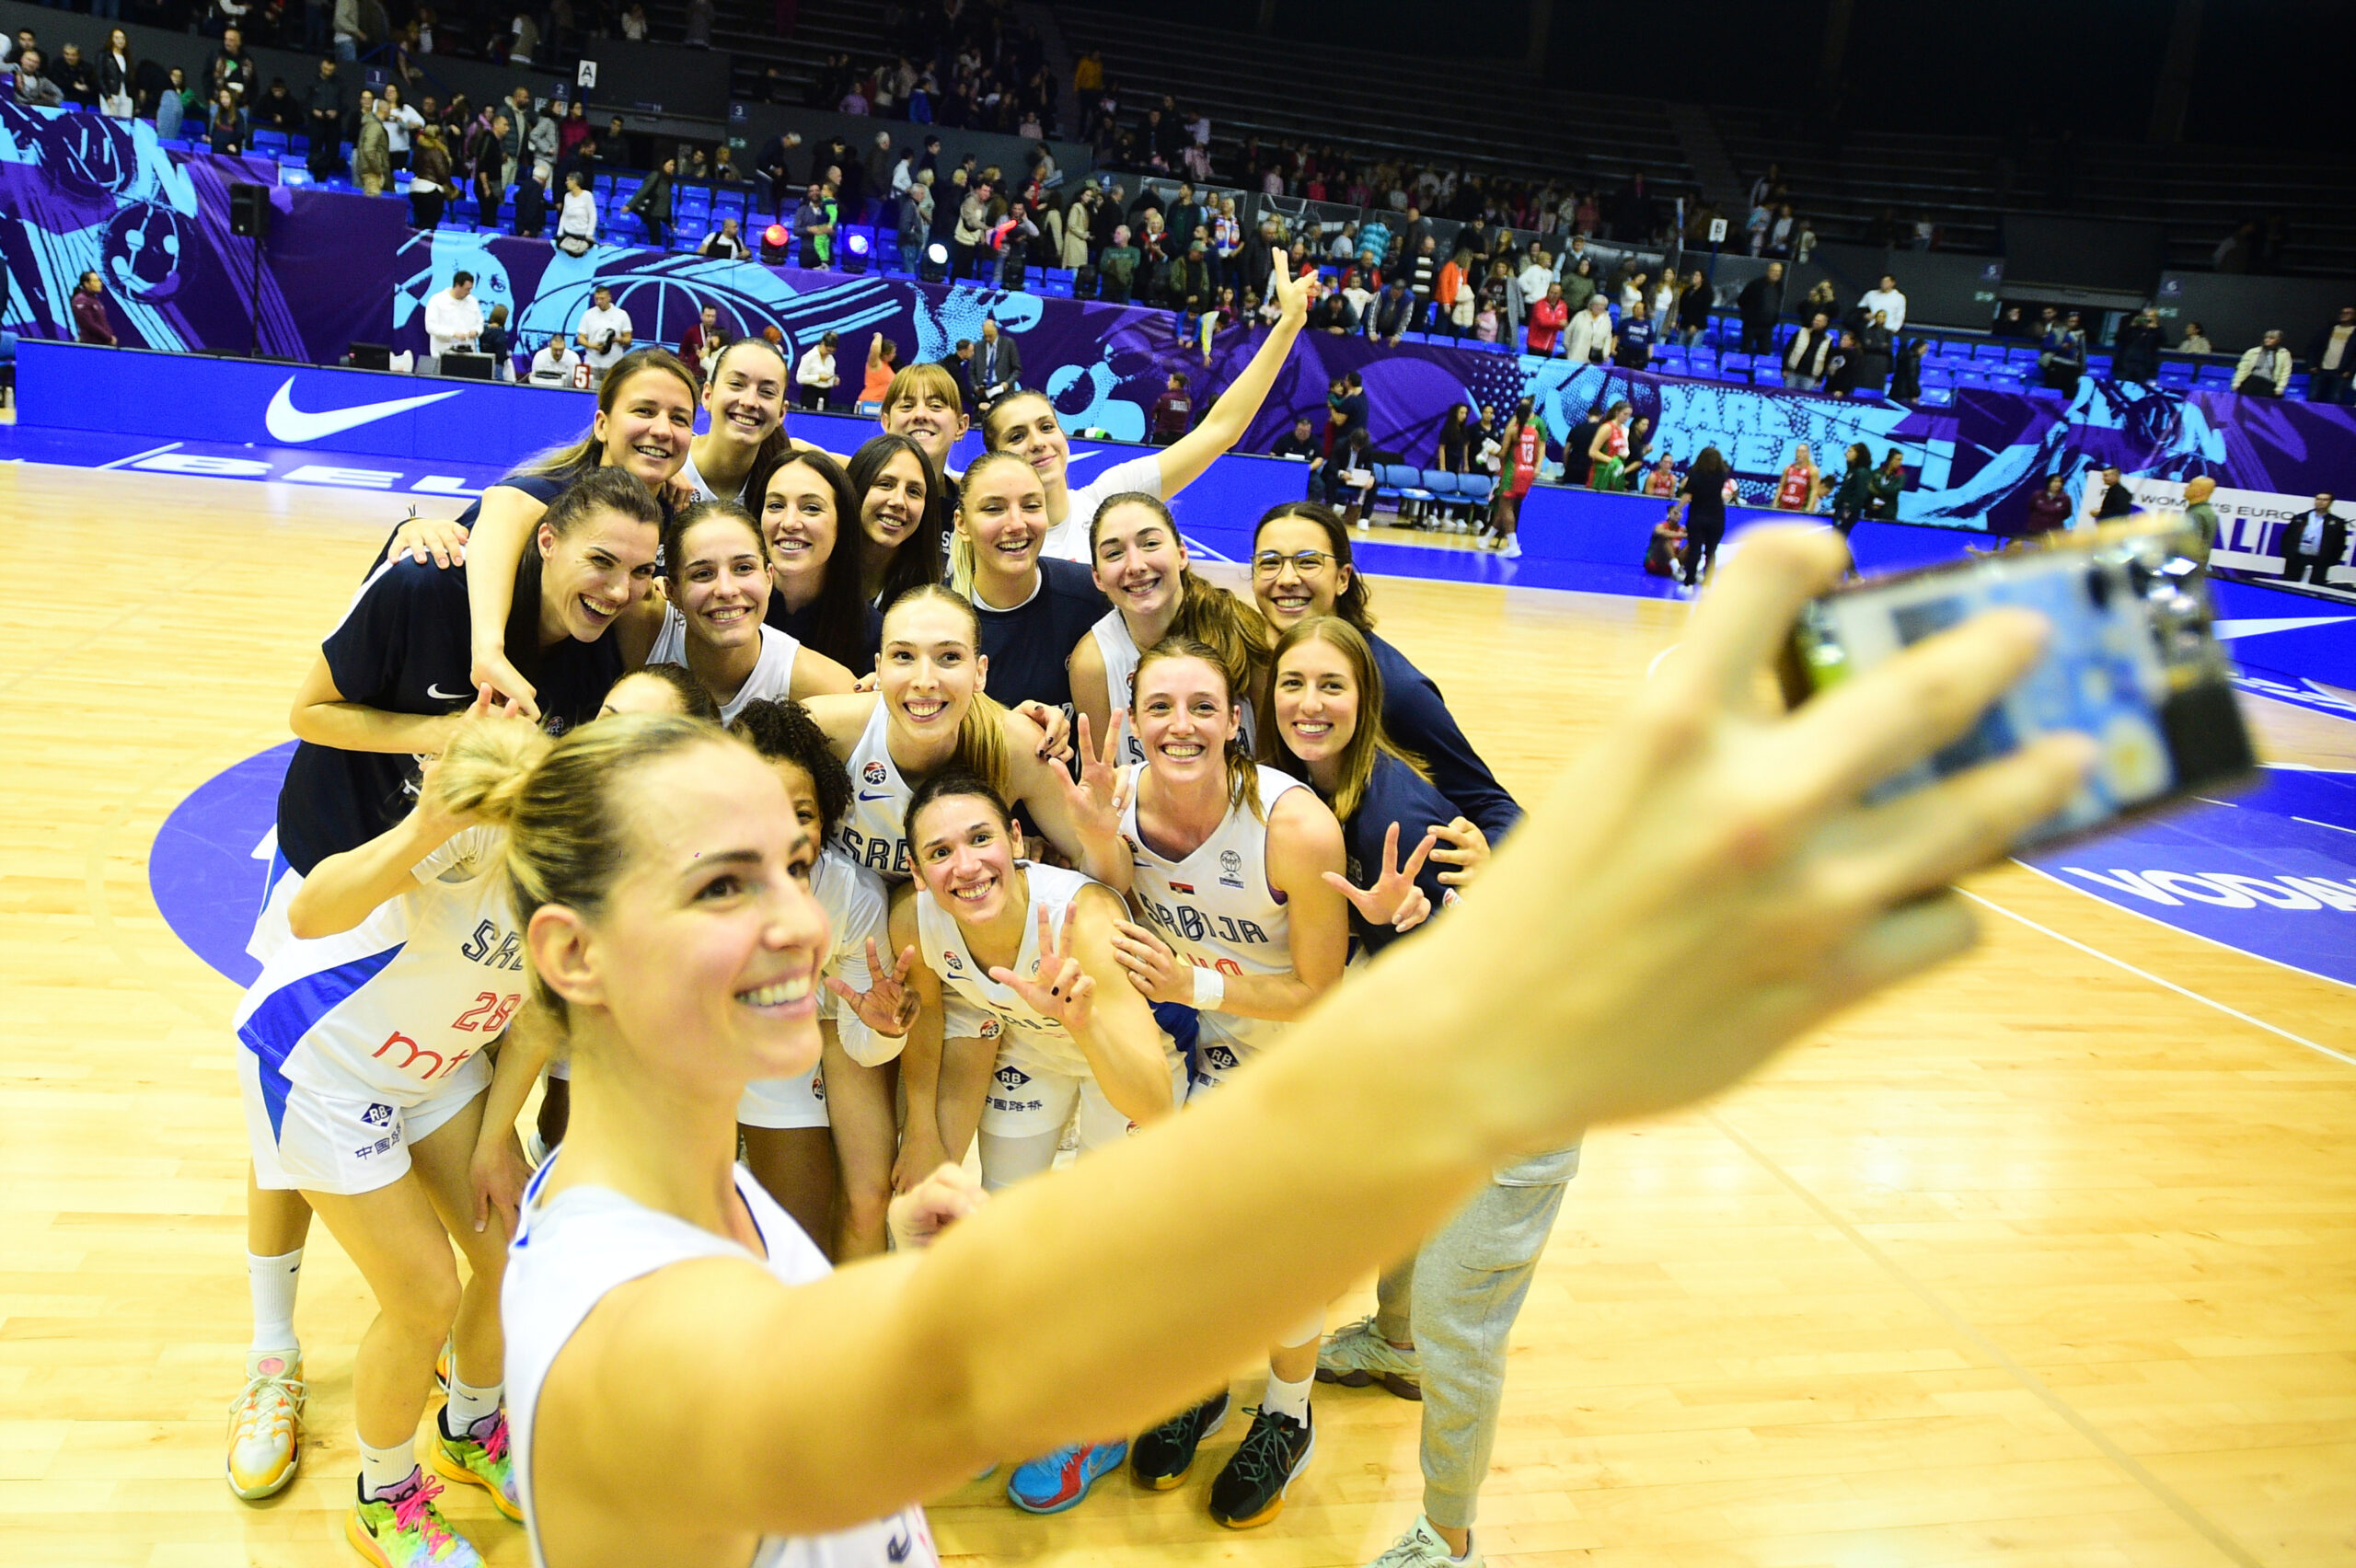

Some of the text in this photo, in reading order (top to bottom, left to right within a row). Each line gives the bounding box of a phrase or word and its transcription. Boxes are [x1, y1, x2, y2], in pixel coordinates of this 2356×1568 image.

[574, 365, 588, 388] 5
[1521, 443, 1535, 463] 13
[2061, 867, 2356, 912] VODA
[1139, 892, 1269, 944] SRBIJA
[451, 991, 521, 1032] 28
[1211, 1049, 1233, 1066] RB
[1000, 1071, 1022, 1084] RB
[369, 1105, 388, 1123] RB
